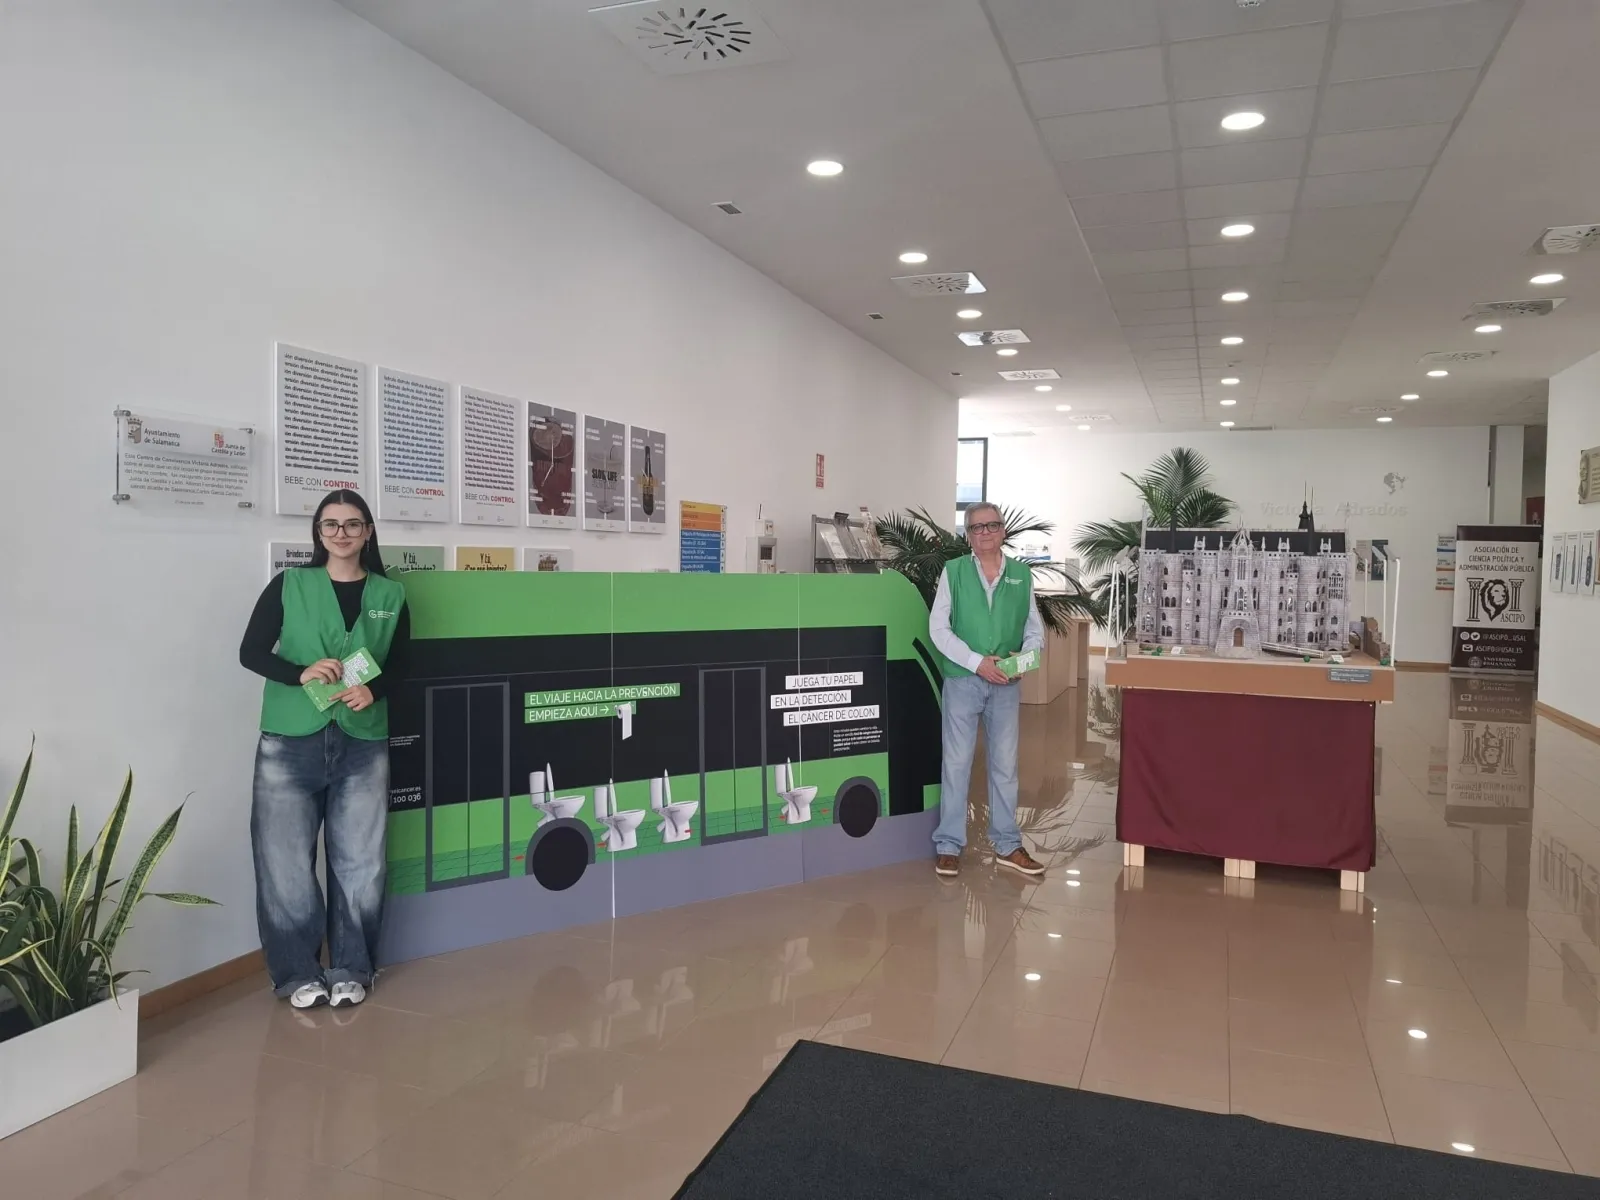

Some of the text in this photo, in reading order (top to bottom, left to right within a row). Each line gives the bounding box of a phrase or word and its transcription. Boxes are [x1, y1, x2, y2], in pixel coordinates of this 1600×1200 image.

[144, 428, 180, 438] Ayuntamiento
[152, 439, 180, 447] Salamanca
[285, 476, 304, 485] BEBE
[306, 478, 322, 486] CON
[324, 480, 360, 490] CONTROL
[385, 485, 445, 497] BEBE CON CONTROL
[465, 492, 477, 500] BEBE
[491, 495, 515, 503] CONTROL
[403, 552, 417, 565] Y tú,
[480, 553, 484, 564] Y
[1492, 555, 1519, 563] POLÍTICA
[1459, 564, 1535, 573] ADMINISTRACIÓN PÚBLICA
[1500, 613, 1526, 623] ASCIPO
[793, 674, 858, 688] JUEGA TU PAPEL
[530, 683, 676, 705] EL VIAJE HACIA LA PREVENCIÓN
[775, 691, 847, 707] EN LA DETECCIÓN
[530, 704, 598, 722] EMPIEZA AQUÍ
[789, 708, 875, 724] EL CÁNCER DE COLON
[393, 793, 422, 804] 100 036
